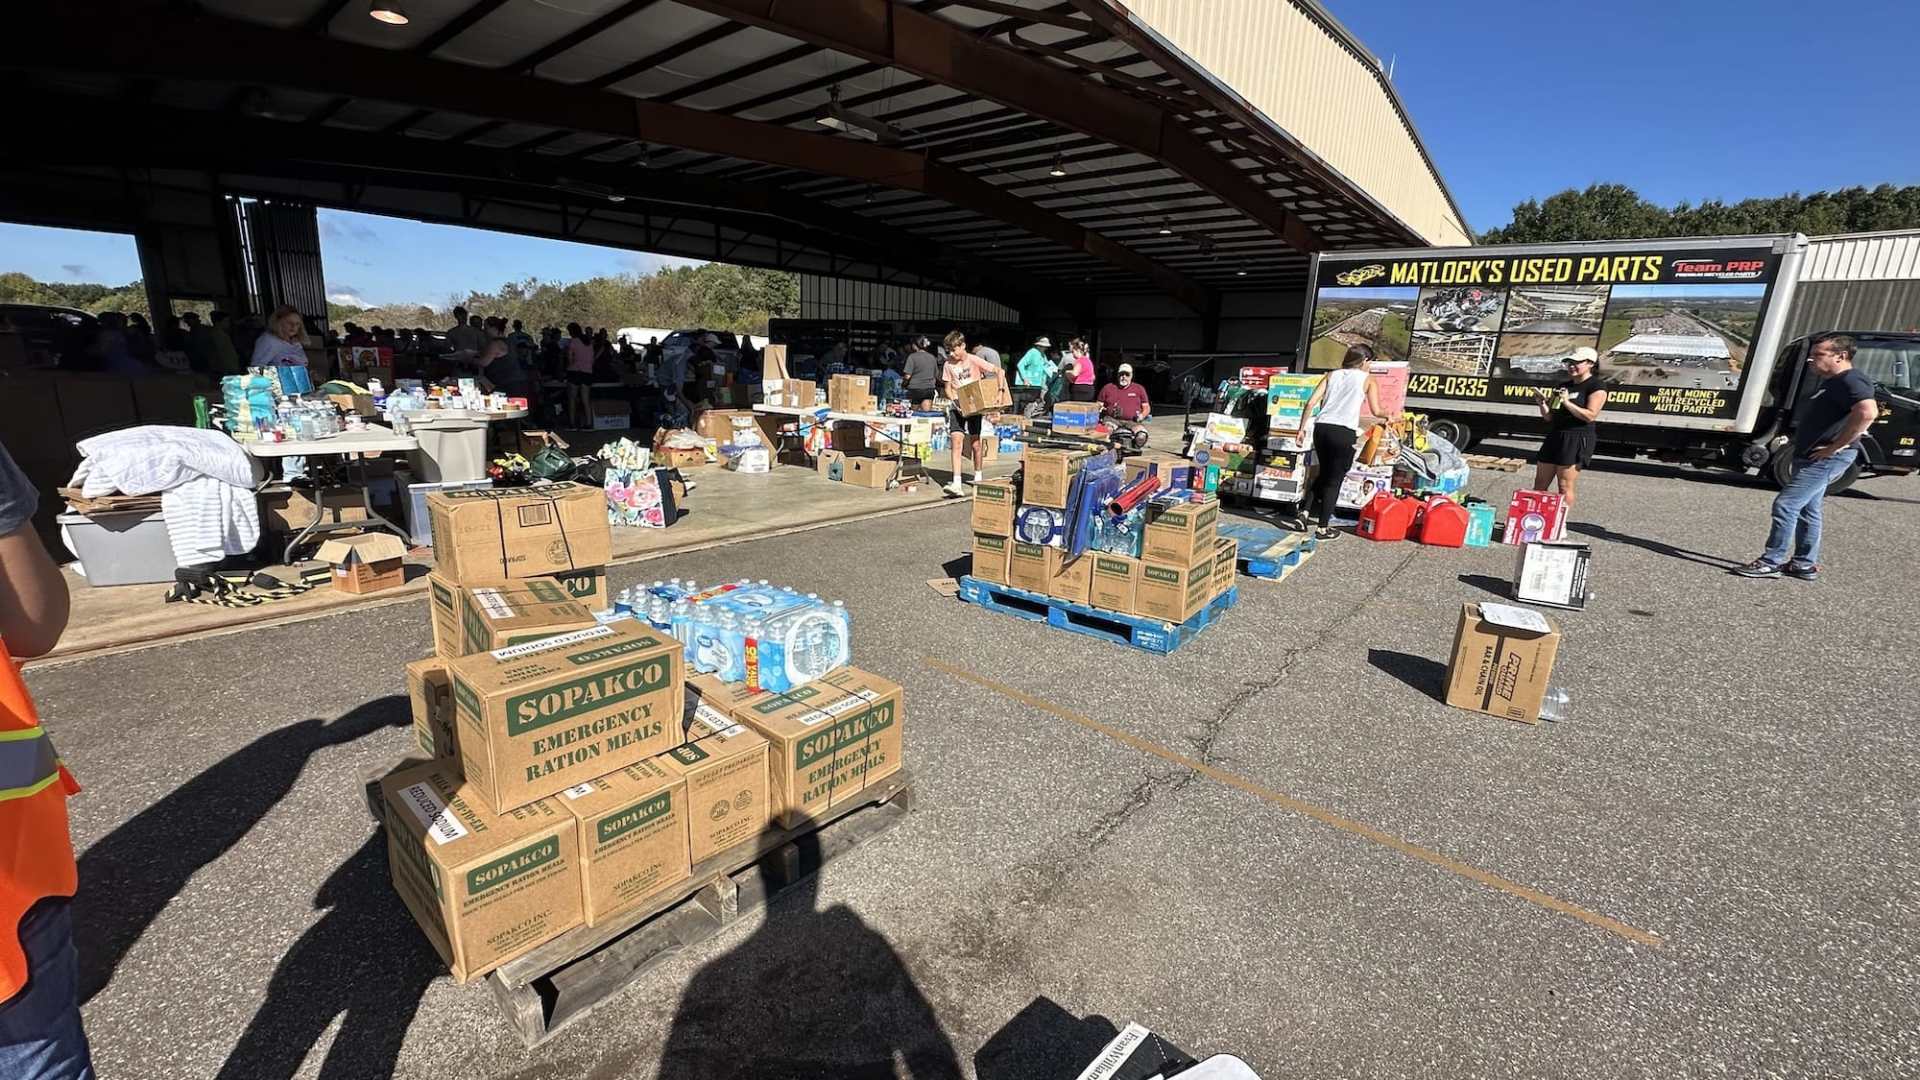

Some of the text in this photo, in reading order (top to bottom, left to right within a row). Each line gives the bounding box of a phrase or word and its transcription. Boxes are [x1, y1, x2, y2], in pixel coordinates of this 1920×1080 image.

[1390, 256, 1663, 284] MATLOCK'S USED PARTS
[1677, 261, 1764, 272] Team PRP
[1408, 374, 1489, 397] 428-0335
[1649, 395, 1725, 408] WITH RECYCLED
[1658, 387, 1719, 399] SAVE MONEY
[1654, 404, 1714, 415] AUTO PARTS
[518, 663, 663, 724] SOPAKCO
[1474, 684, 1484, 696] OIL
[1477, 664, 1489, 685] CHAIN
[1502, 653, 1520, 699] PRIME
[532, 703, 653, 756] EMERGENCY
[802, 706, 889, 761] SOPAKCO
[526, 721, 662, 782] RATION MEALS
[808, 738, 882, 784] EMERGENCY
[803, 751, 886, 804] RATION MEALS
[408, 785, 459, 839] REDUCED SODIUM
[603, 800, 665, 835] SOPAKCO
[475, 844, 553, 886] SOPAKCO
